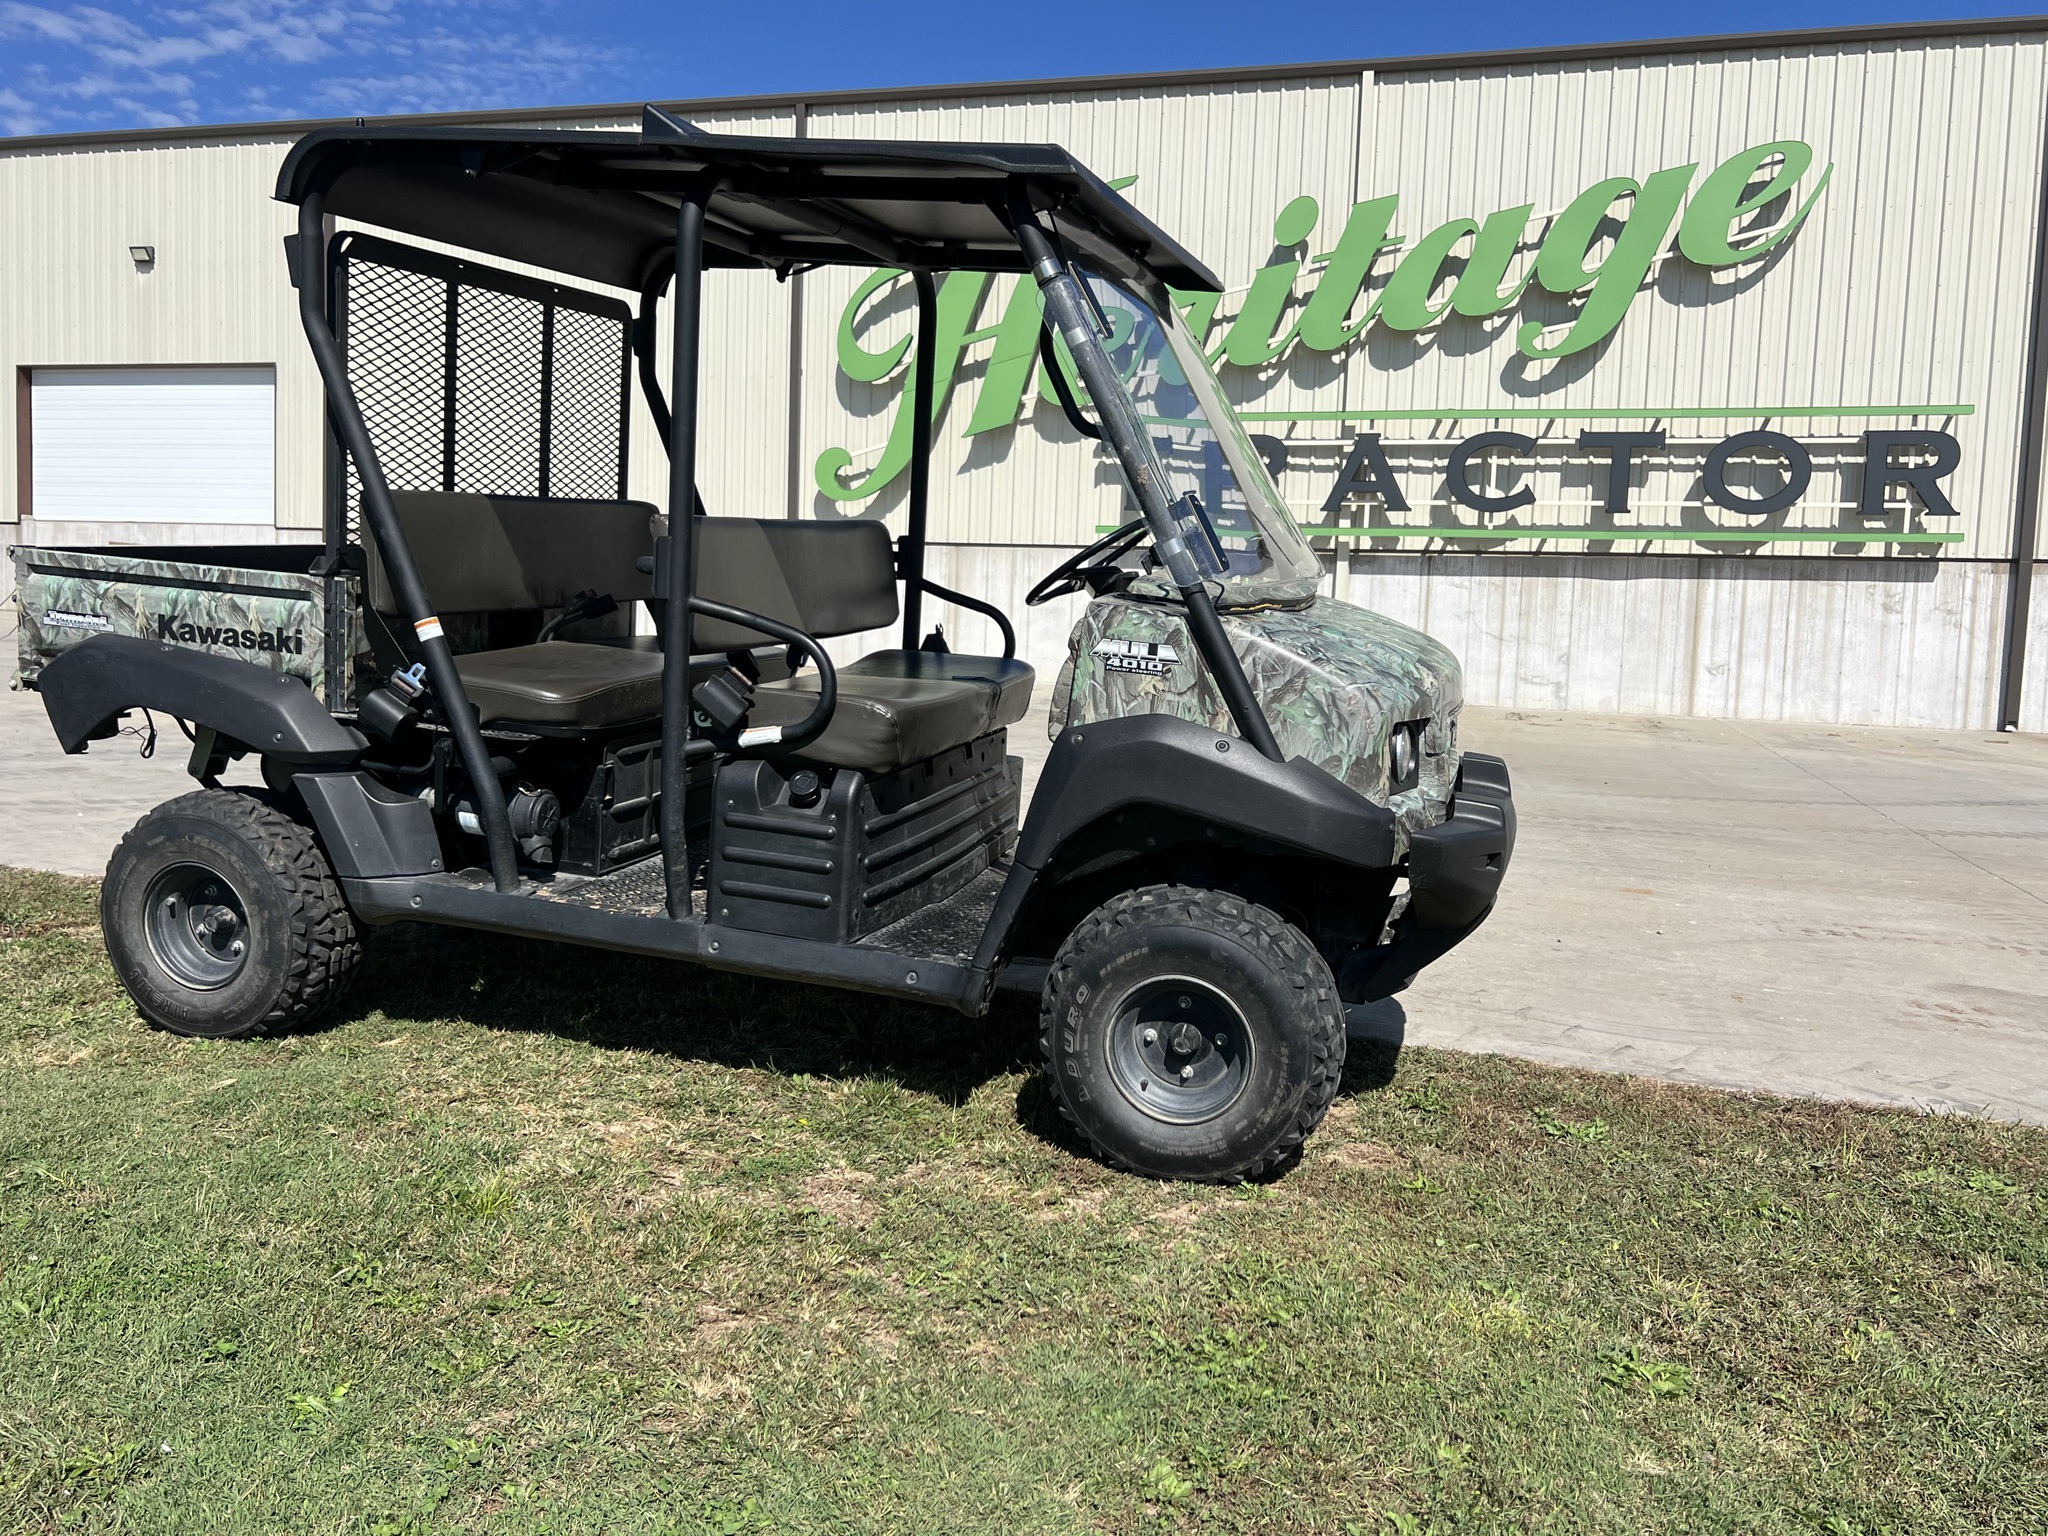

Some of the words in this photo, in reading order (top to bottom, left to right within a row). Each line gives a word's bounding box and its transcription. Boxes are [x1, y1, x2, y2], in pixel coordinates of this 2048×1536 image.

[1100, 428, 1961, 517] RACTOR
[158, 613, 303, 655] Kawasaki
[1089, 638, 1182, 665] MULE
[1106, 658, 1164, 672] 4010
[1106, 665, 1130, 673] Power
[1131, 668, 1163, 677] steering
[1063, 982, 1091, 1079] DURO
